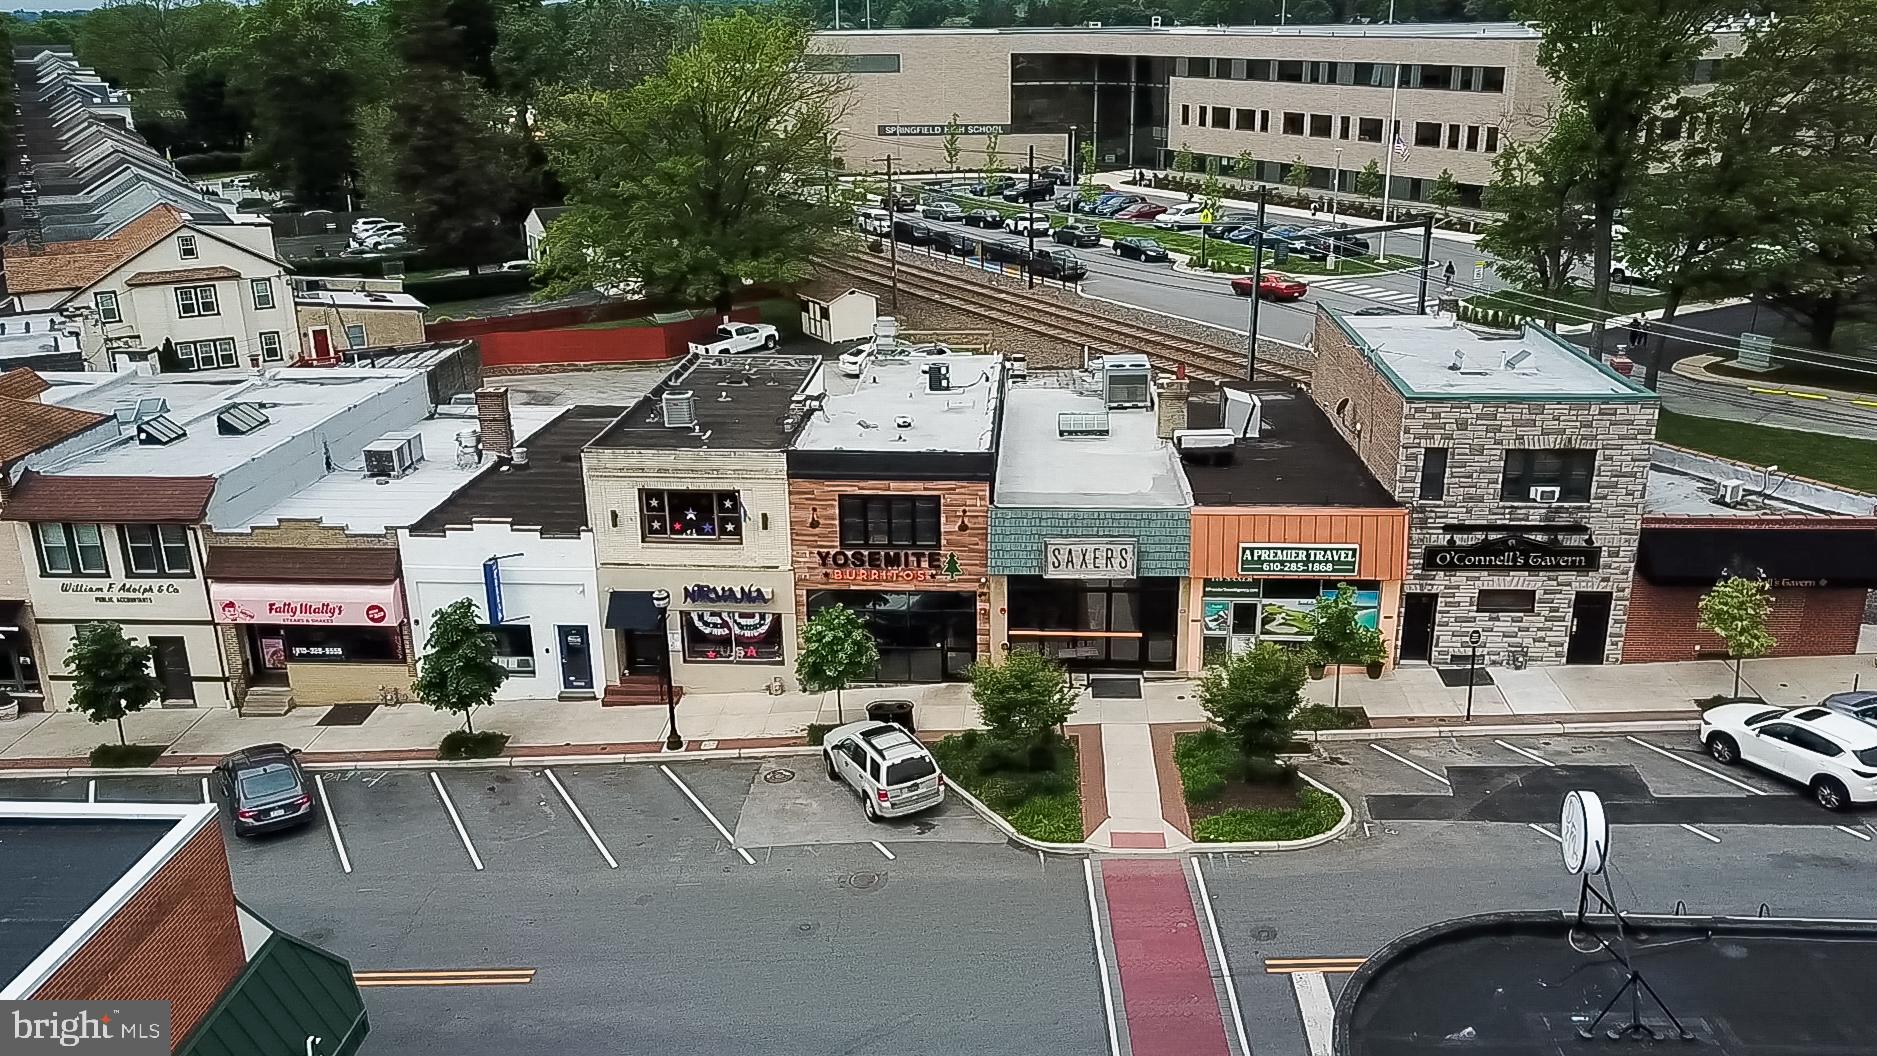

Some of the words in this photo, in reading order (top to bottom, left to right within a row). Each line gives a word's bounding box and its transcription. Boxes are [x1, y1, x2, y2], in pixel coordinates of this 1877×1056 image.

[885, 126, 942, 134] SPRINGFIELD
[967, 125, 1004, 134] SCHOOL
[816, 550, 943, 569] YOSEMITE
[1051, 547, 1128, 569] SAXERS
[1243, 549, 1251, 561] A
[1253, 549, 1307, 561] PREMIER
[1308, 550, 1356, 561] TRAVEL
[1436, 551, 1525, 566] O'Connell's
[1529, 552, 1586, 566] Tavern
[1262, 562, 1333, 571] 610-285-1868
[833, 569, 926, 581] BURRITOS
[60, 582, 104, 593] William
[118, 582, 154, 596] Adolph
[157, 584, 164, 594] &
[683, 583, 775, 604] NIRVANA
[268, 602, 301, 617] Fatty
